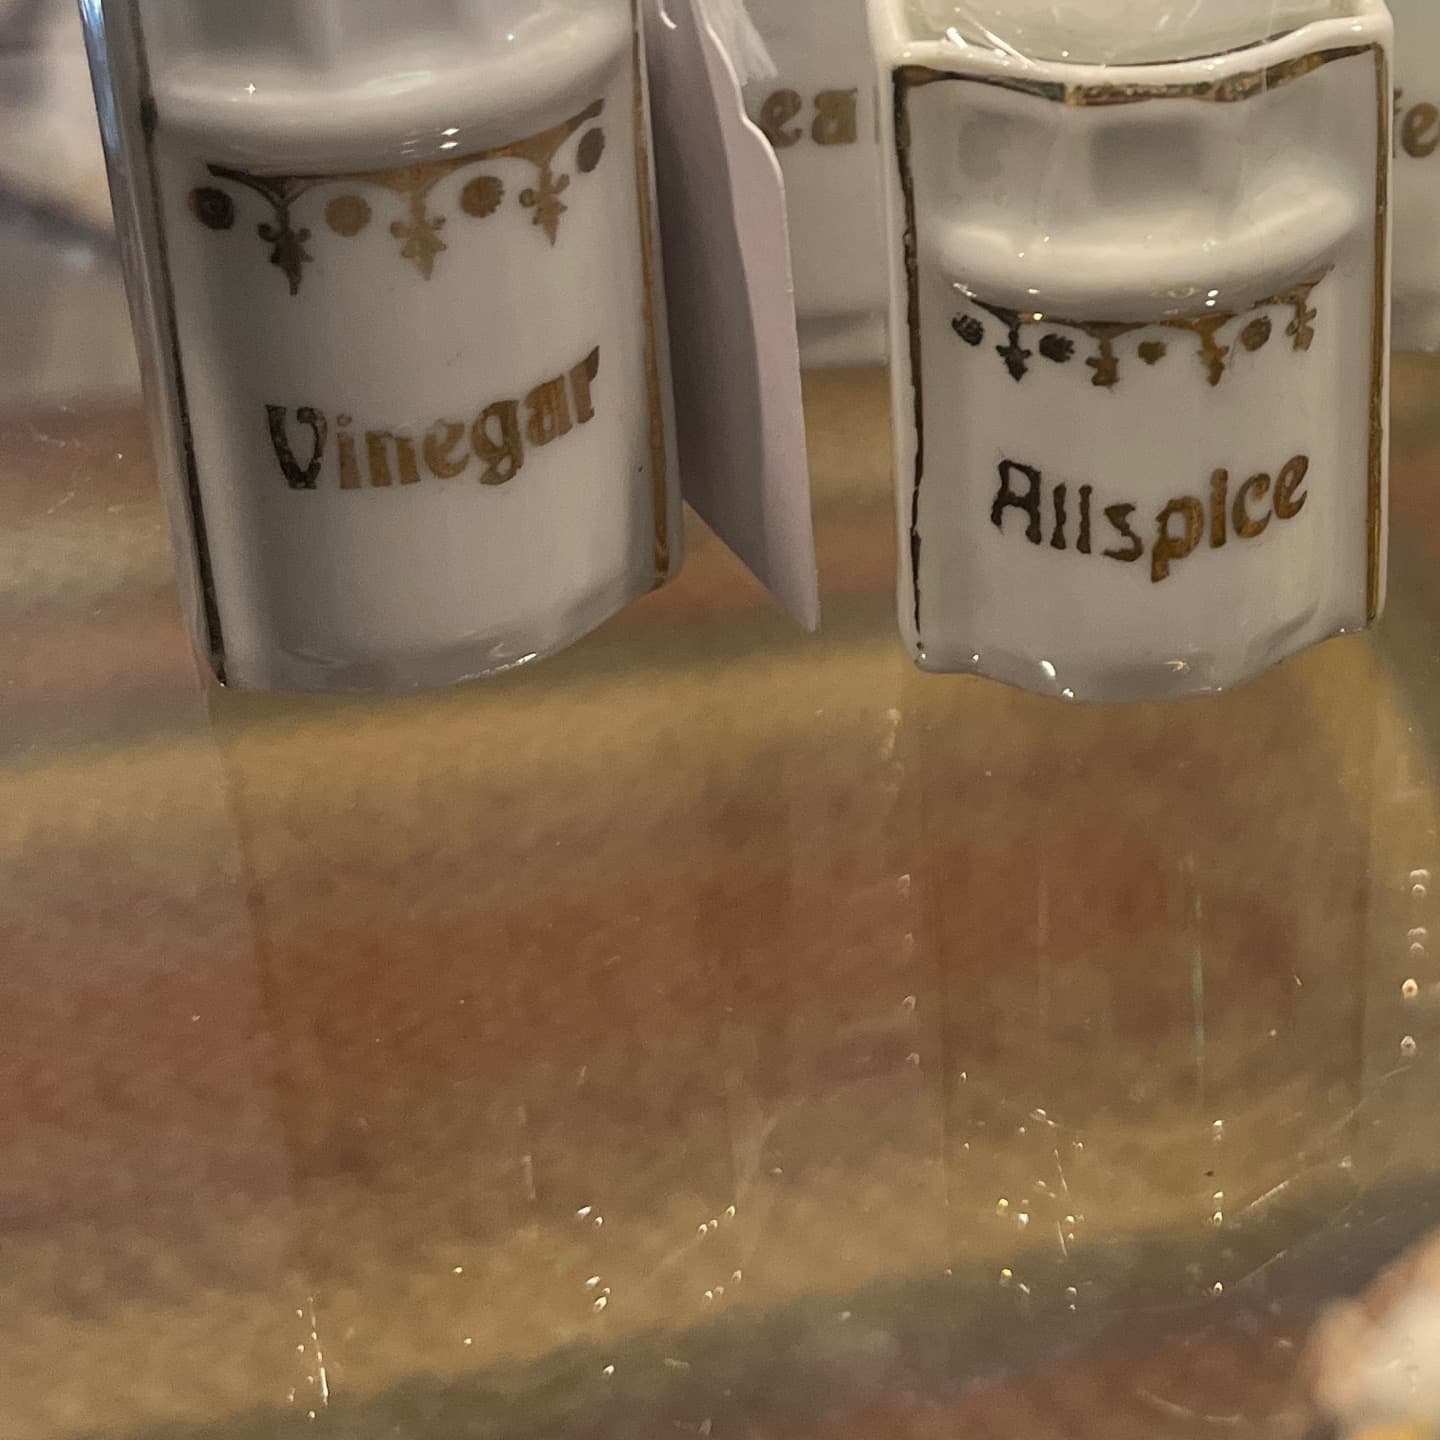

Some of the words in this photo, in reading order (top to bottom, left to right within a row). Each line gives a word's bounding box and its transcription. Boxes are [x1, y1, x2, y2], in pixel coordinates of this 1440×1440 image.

[759, 87, 858, 149] ea
[265, 345, 600, 490] Vinegar
[990, 454, 1309, 583] Allspice
